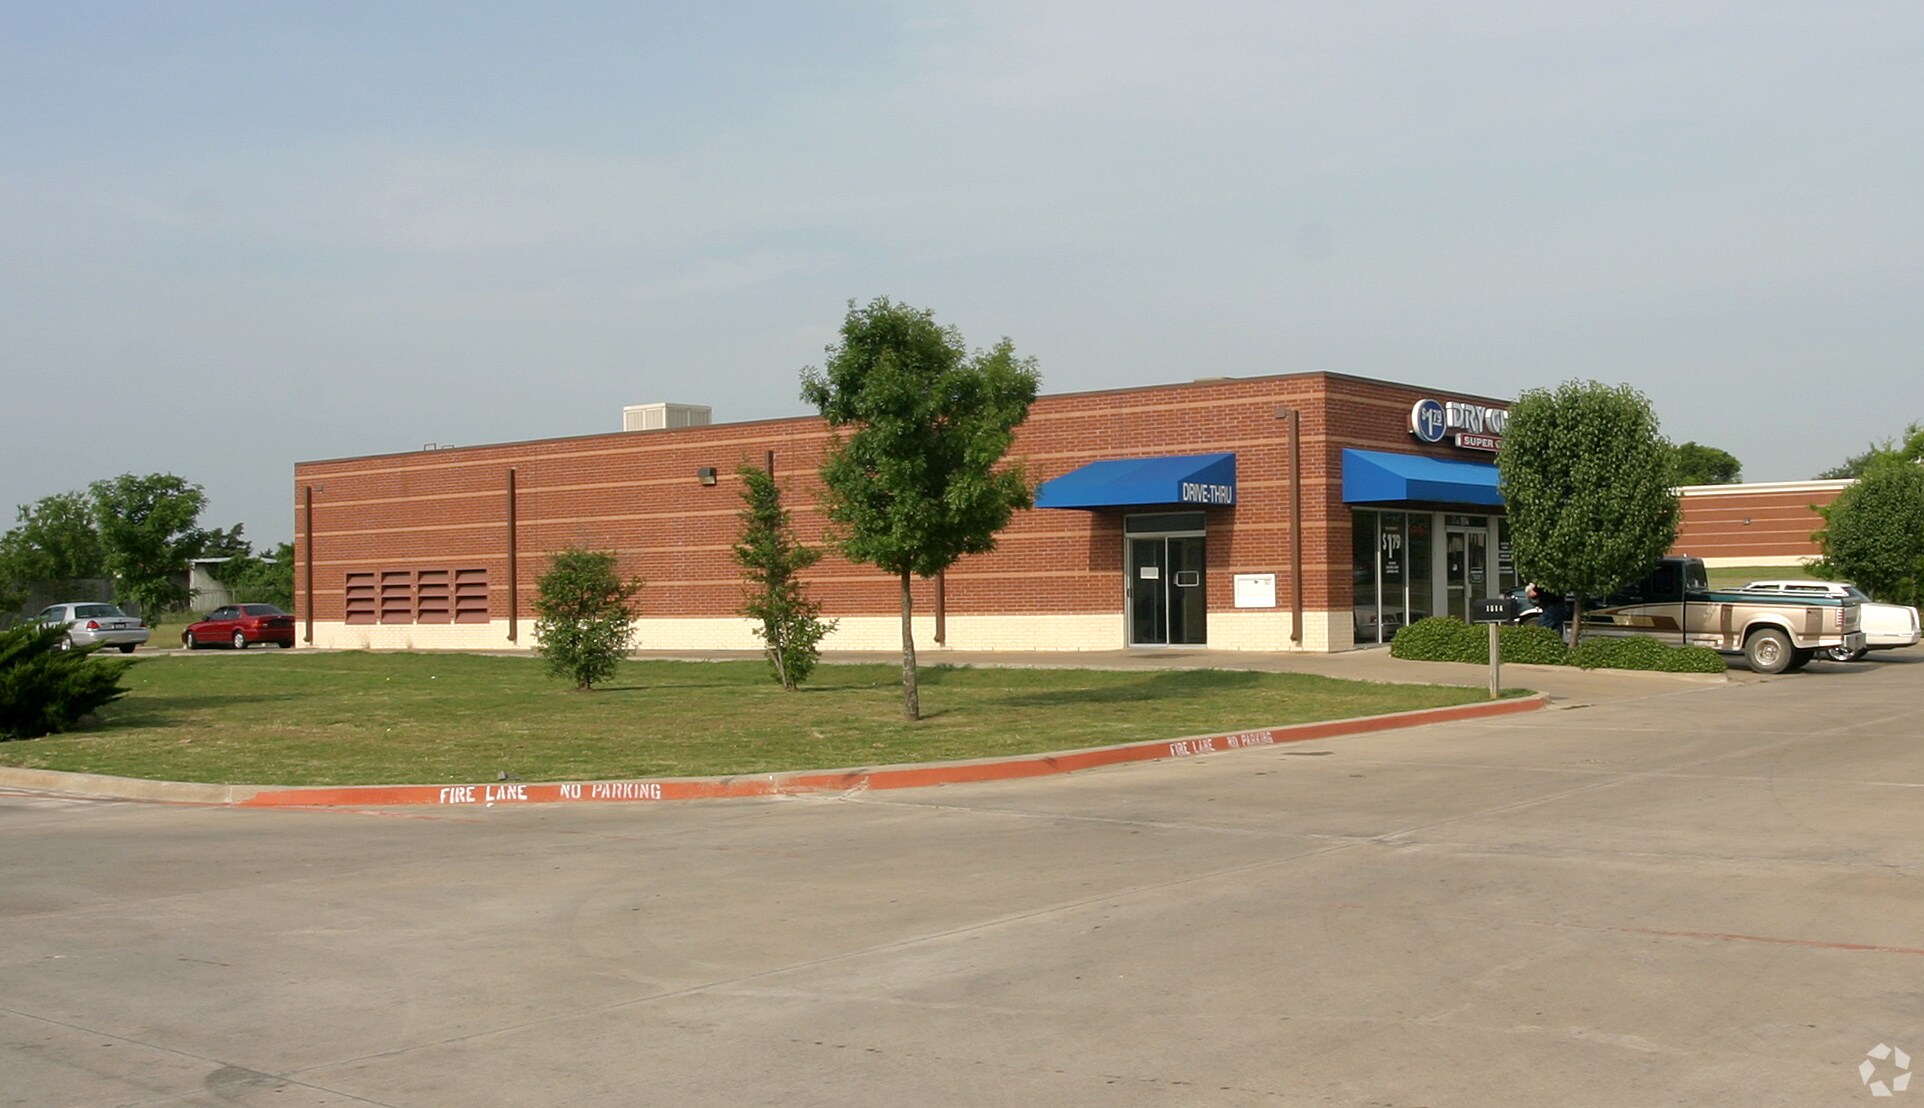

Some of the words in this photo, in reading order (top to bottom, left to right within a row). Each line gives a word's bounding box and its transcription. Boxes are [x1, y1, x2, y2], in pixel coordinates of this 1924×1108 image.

[1446, 402, 1486, 433] DRY
[1463, 436, 1494, 448] SUPER
[1183, 482, 1232, 503] DRIVE-THRU
[1169, 741, 1191, 757] FIRE
[1192, 738, 1216, 754] LANE
[1226, 736, 1239, 748] NO
[1241, 731, 1274, 749] PARKING
[440, 786, 476, 803] FIRE
[486, 784, 528, 801] LANE
[560, 783, 581, 799] NO
[592, 783, 661, 800] PARKING
